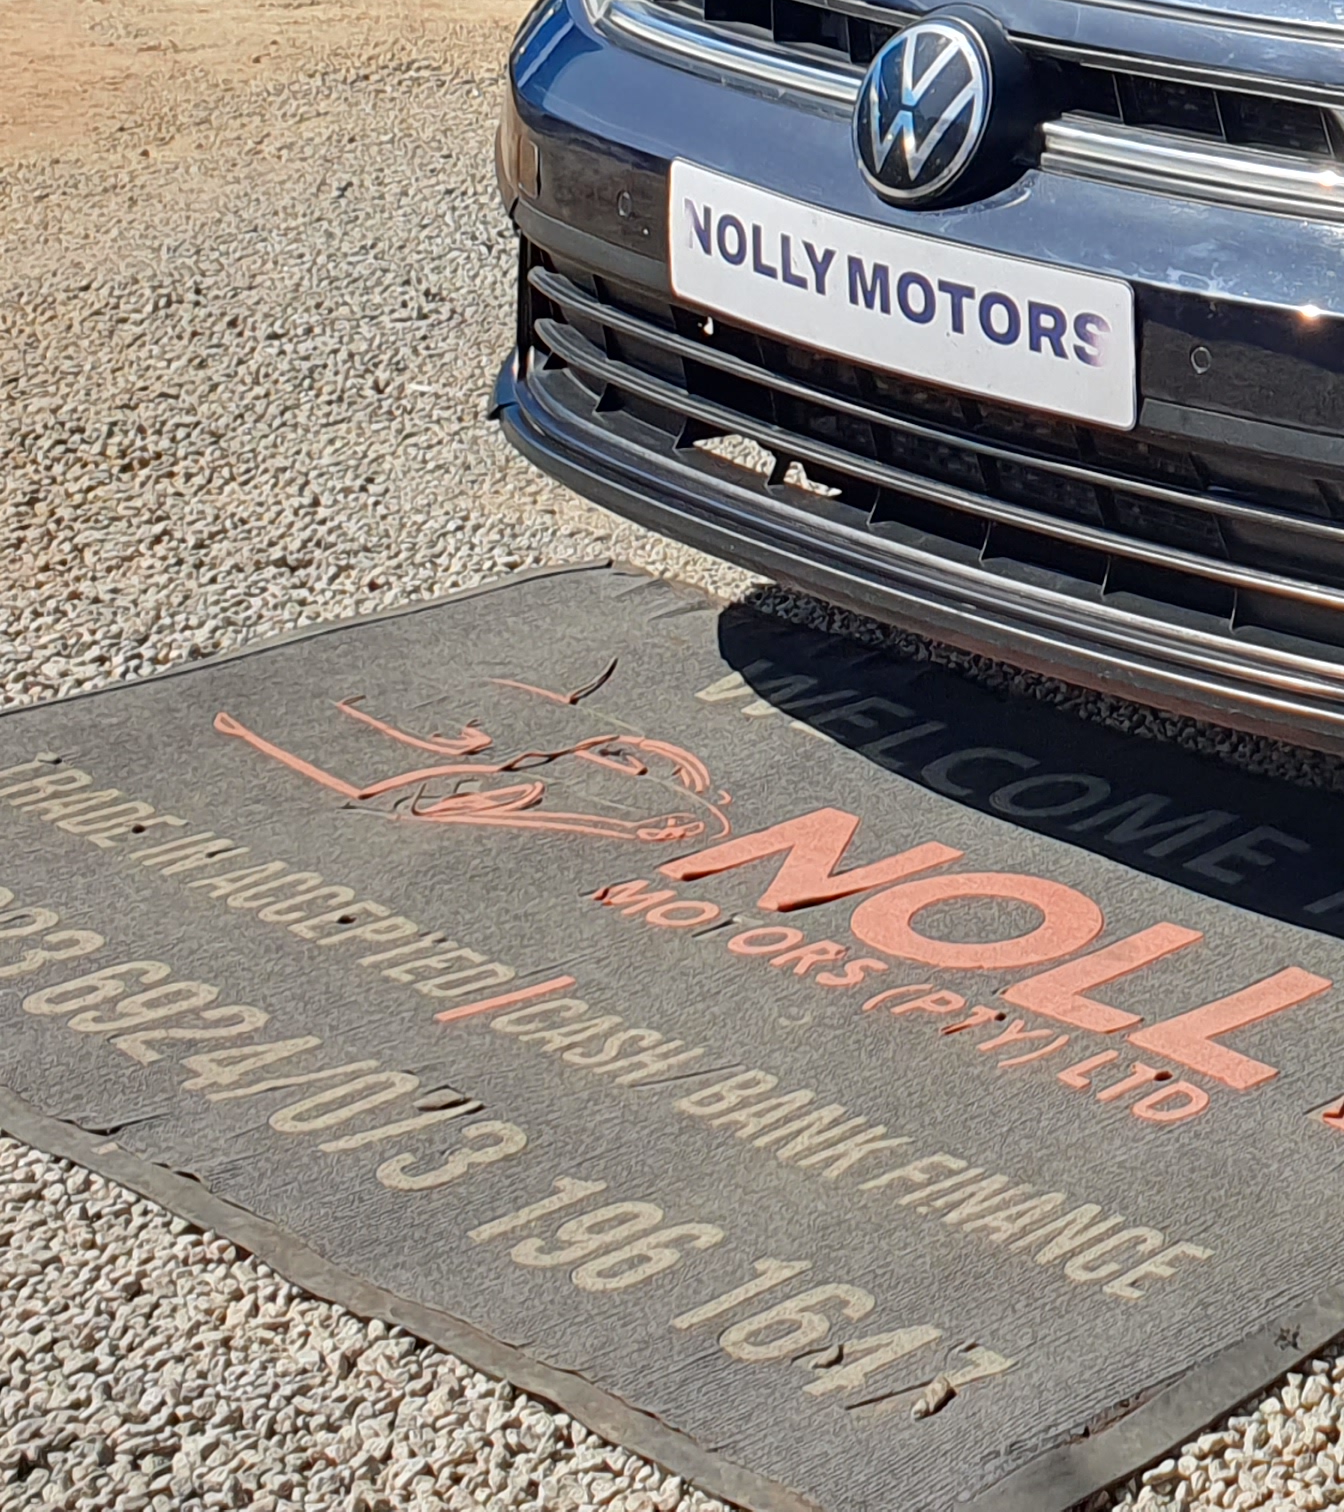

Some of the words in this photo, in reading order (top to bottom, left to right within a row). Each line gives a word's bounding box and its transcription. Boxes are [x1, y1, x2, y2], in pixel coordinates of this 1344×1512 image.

[684, 197, 836, 295] NOLLY
[847, 254, 1111, 368] MOTORS
[698, 658, 1310, 885] WELCOME
[129, 831, 250, 876] IN
[861, 1153, 1215, 1300] FINANCE
[594, 878, 889, 987] MOTORS
[861, 983, 1070, 1068] (PTY)
[1056, 1049, 1211, 1124] LTD
[467, 1176, 725, 1292] 196
